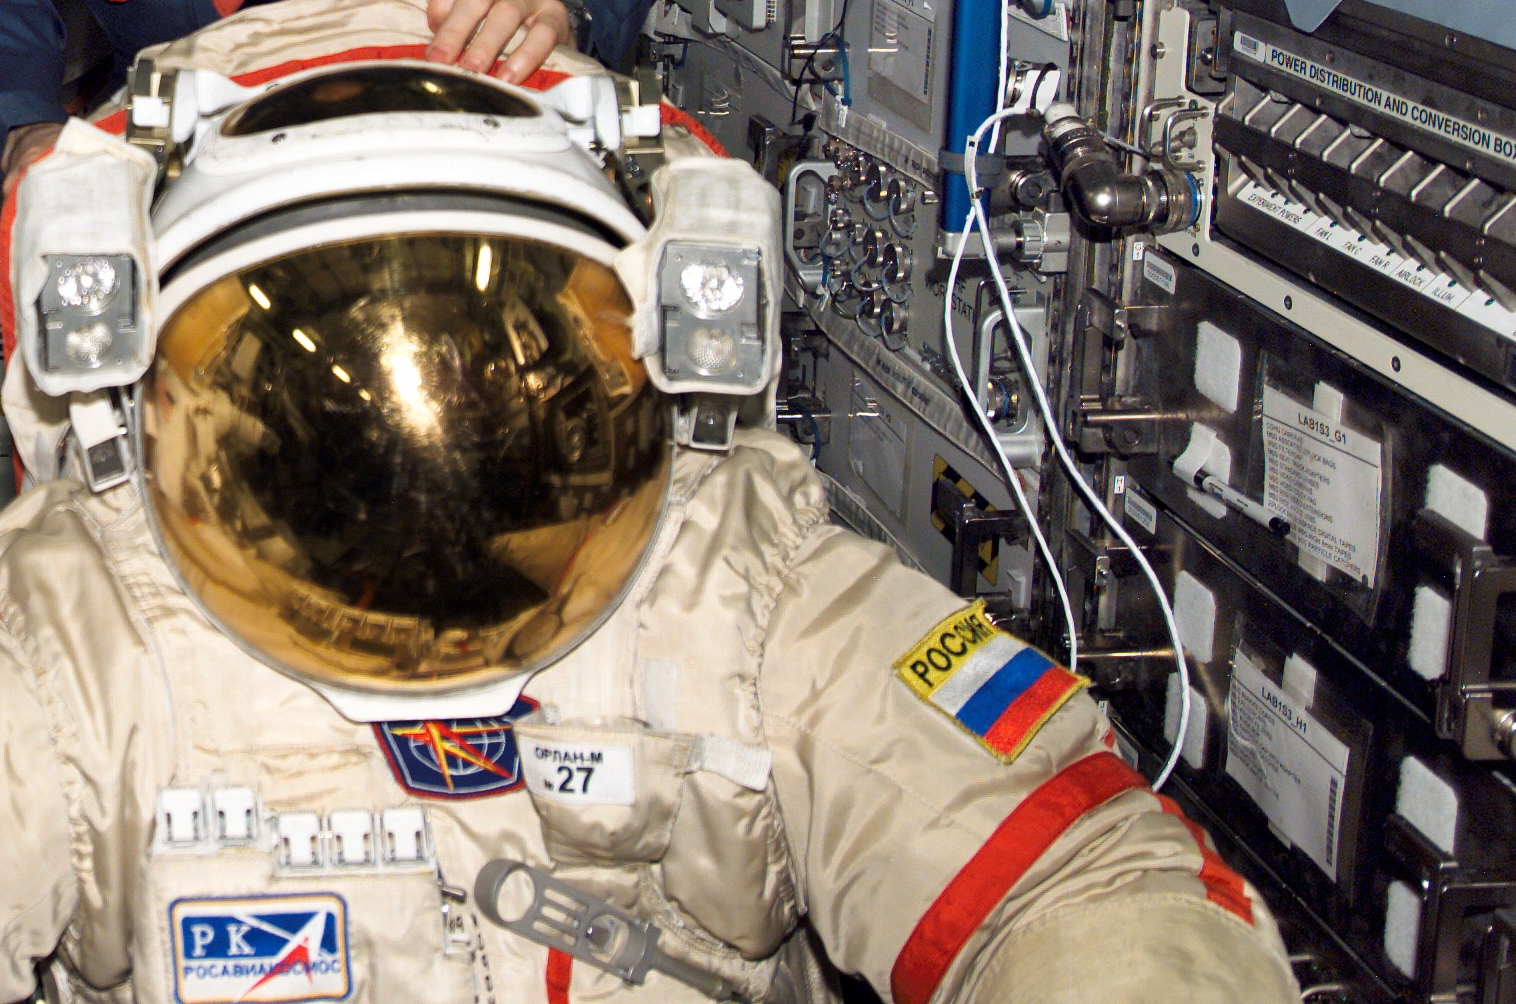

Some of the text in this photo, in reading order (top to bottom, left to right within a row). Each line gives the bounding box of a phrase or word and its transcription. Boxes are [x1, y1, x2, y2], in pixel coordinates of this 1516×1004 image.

[1270, 48, 1307, 75] POWER
[1309, 64, 1383, 106] DISTRIBUTION
[1383, 95, 1409, 116] AND
[1411, 105, 1491, 147] CONVERSION
[1369, 255, 1385, 266] FAN
[1297, 412, 1346, 445] LAB1S3_G1
[535, 746, 603, 764] ОРЛАН-М
[557, 765, 595, 794] 27
[183, 960, 342, 980] РОСАВИАКОСМОС
